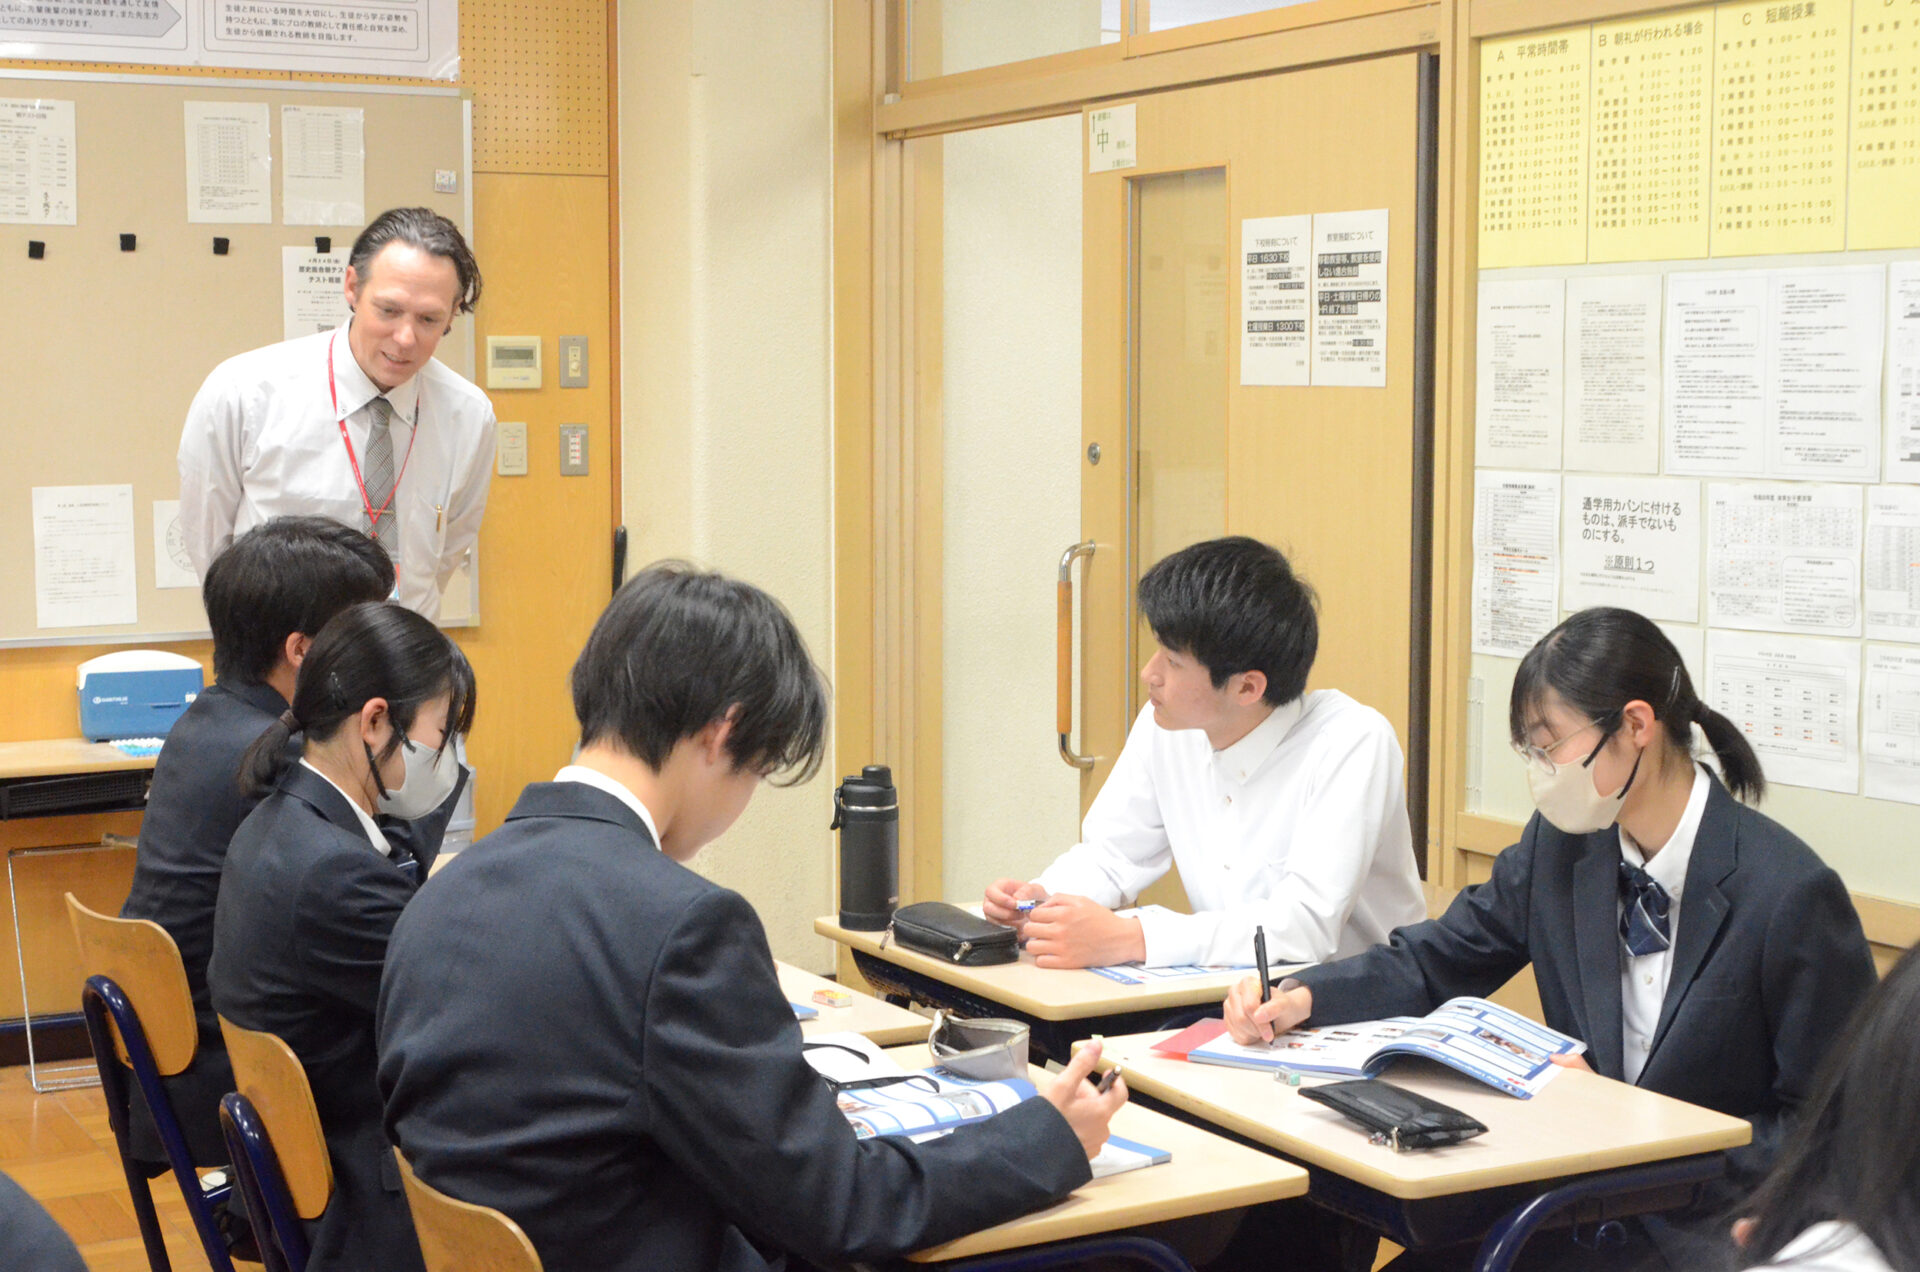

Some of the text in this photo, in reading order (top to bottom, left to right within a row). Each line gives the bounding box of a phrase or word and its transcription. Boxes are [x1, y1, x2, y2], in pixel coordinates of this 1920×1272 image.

[225, 27, 358, 43] 生徒から信頼される教師を目指します。
[1598, 34, 1607, 47] B
[1497, 39, 1569, 62] A 平常時間帯
[1097, 128, 1109, 153] 中
[1582, 496, 1682, 517] 通学用カバンに付ける
[1582, 512, 1677, 532] ものは、派手でないも
[1582, 528, 1625, 544] のにする。
